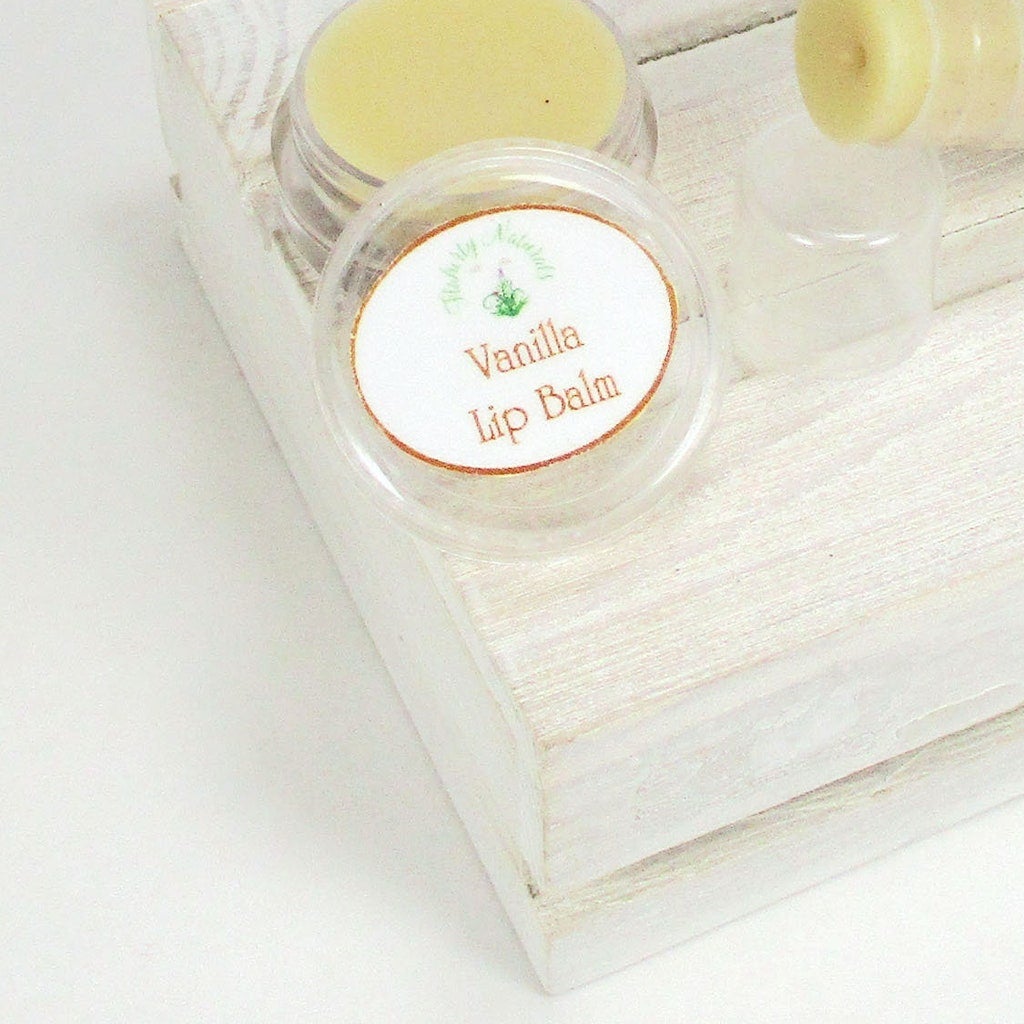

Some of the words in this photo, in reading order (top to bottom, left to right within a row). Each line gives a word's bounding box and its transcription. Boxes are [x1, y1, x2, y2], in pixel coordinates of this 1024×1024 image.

[464, 317, 586, 380] Vanilla
[468, 403, 529, 445] Lip
[534, 368, 622, 422] Balm
